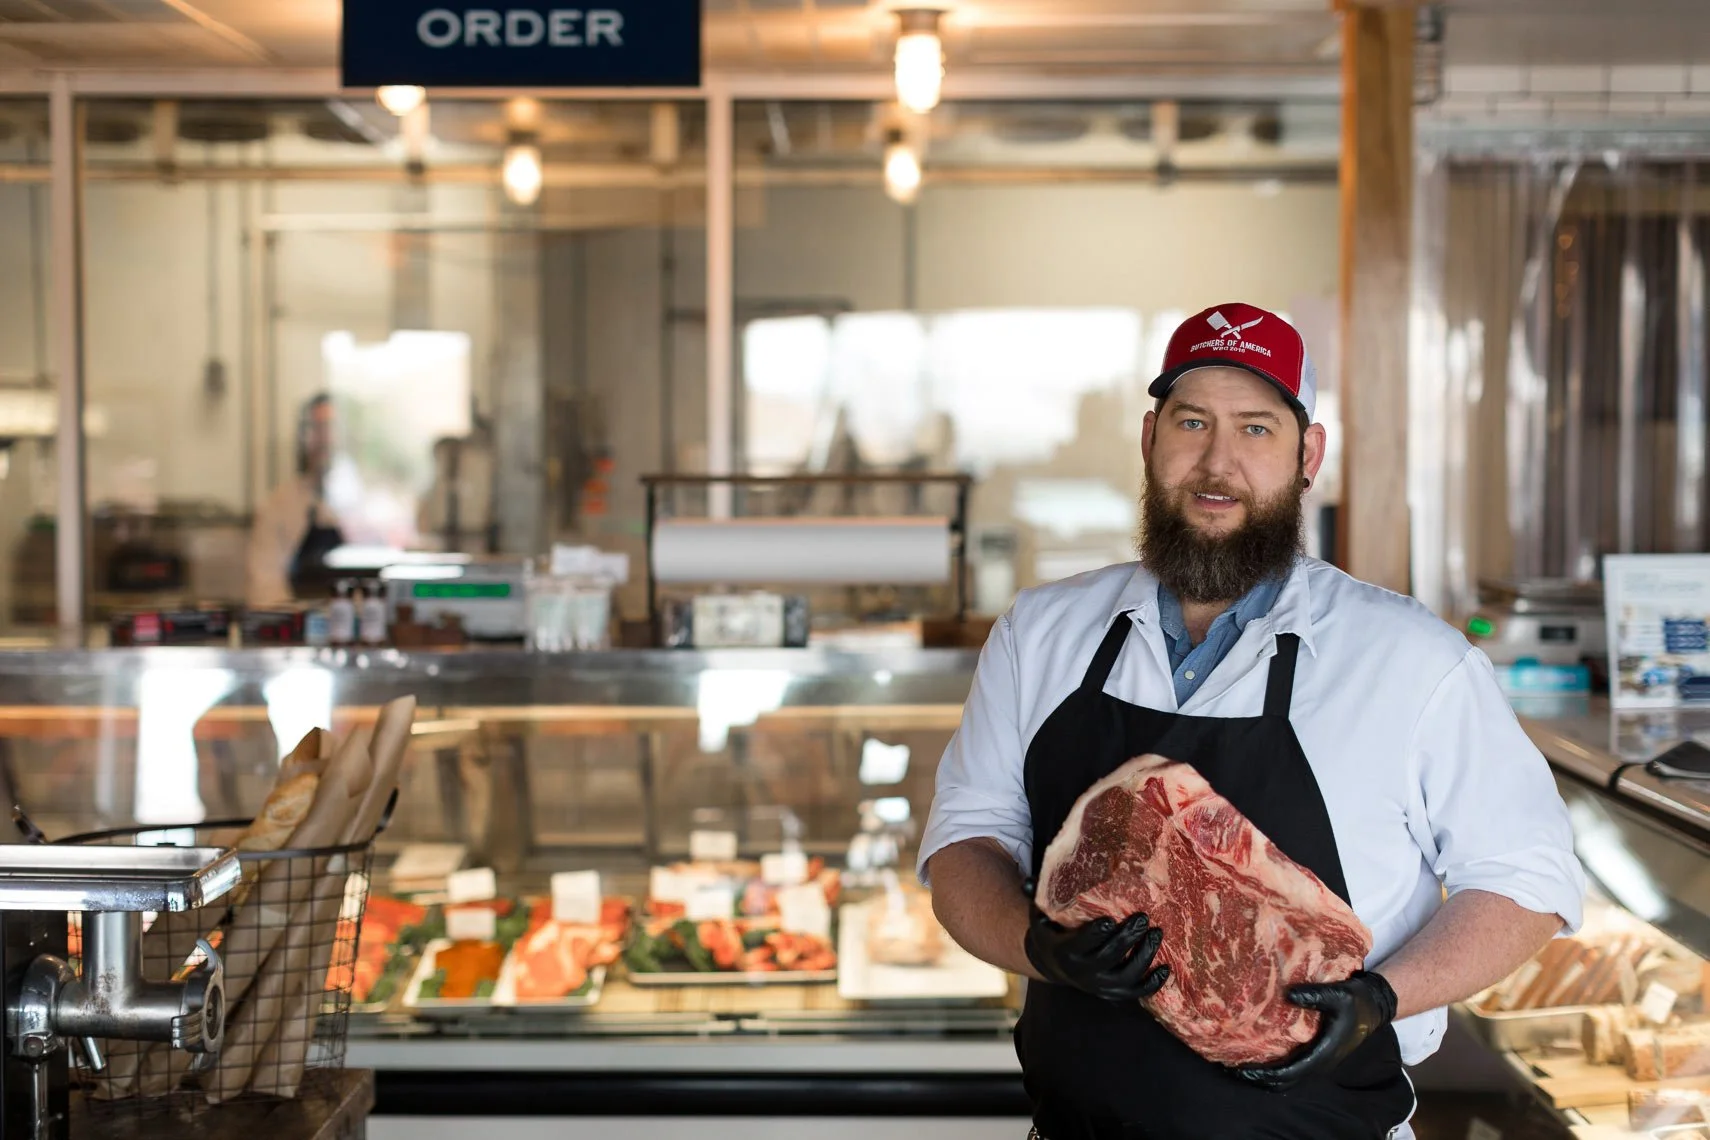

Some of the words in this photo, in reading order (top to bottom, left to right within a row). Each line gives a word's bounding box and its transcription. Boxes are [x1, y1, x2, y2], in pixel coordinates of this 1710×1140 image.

[417, 9, 624, 47] ORDER
[1190, 339, 1224, 352] BUTCHERS
[1227, 339, 1238, 347] OF
[1239, 341, 1271, 357] AMERICA
